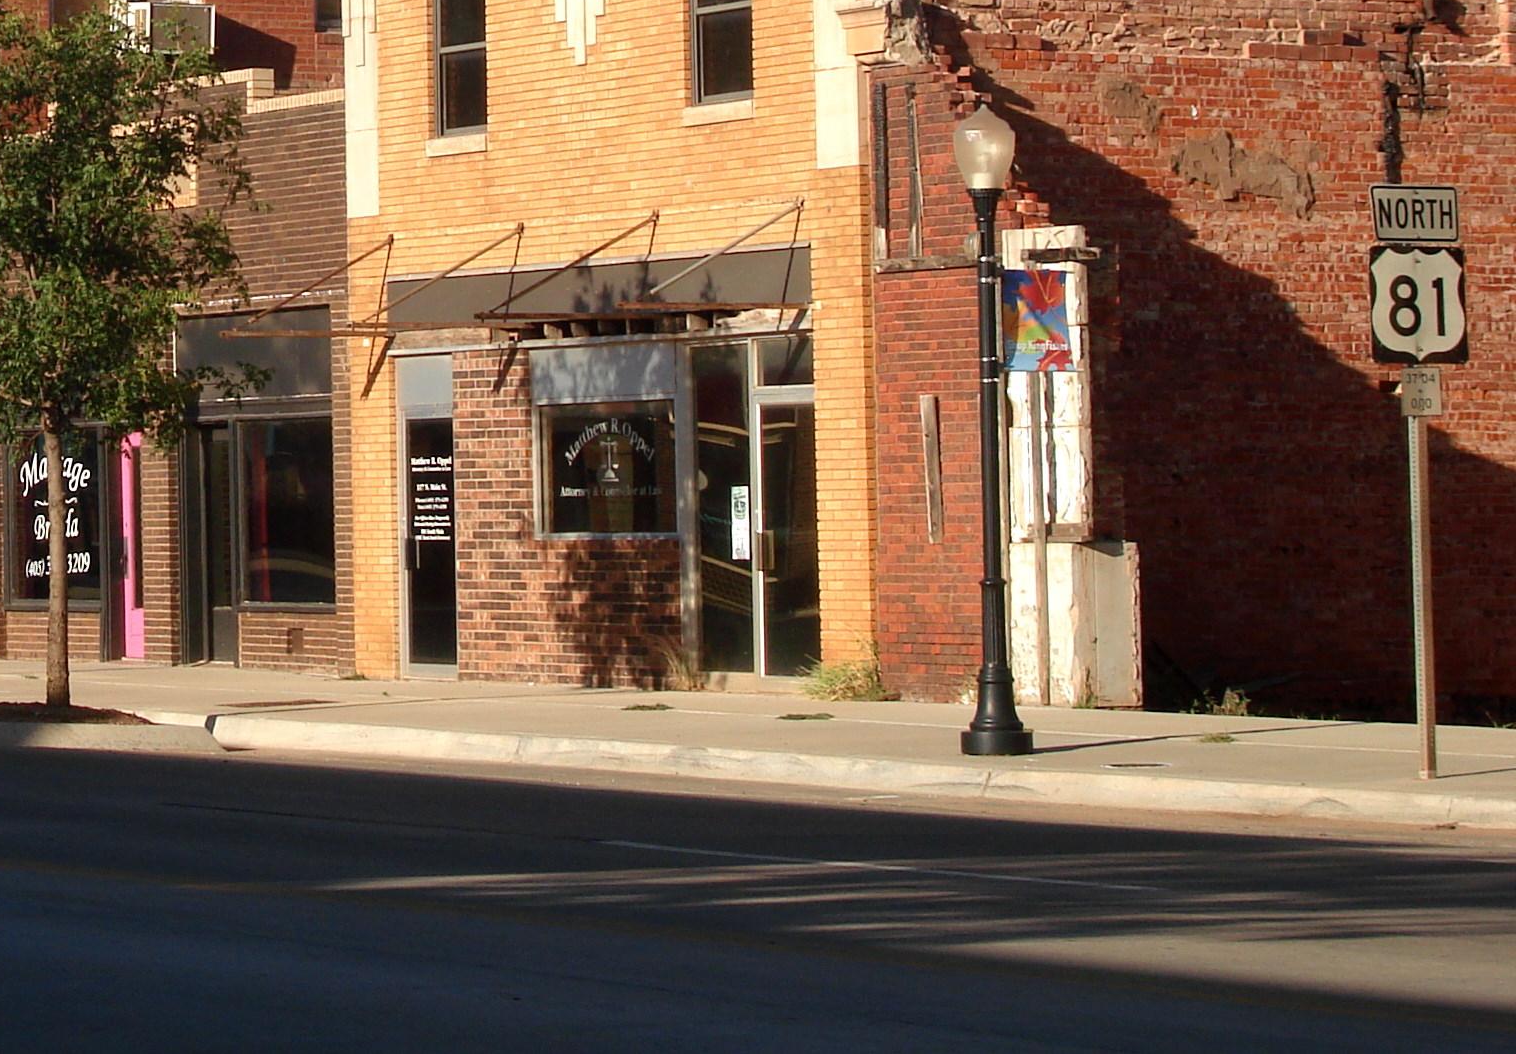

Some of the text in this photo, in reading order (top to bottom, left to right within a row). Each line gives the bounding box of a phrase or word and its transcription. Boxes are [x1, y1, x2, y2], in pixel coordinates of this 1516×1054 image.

[1378, 198, 1453, 230] NORTH
[1389, 274, 1446, 337] 81
[565, 421, 609, 466] Matthew
[622, 422, 655, 461] Oppel
